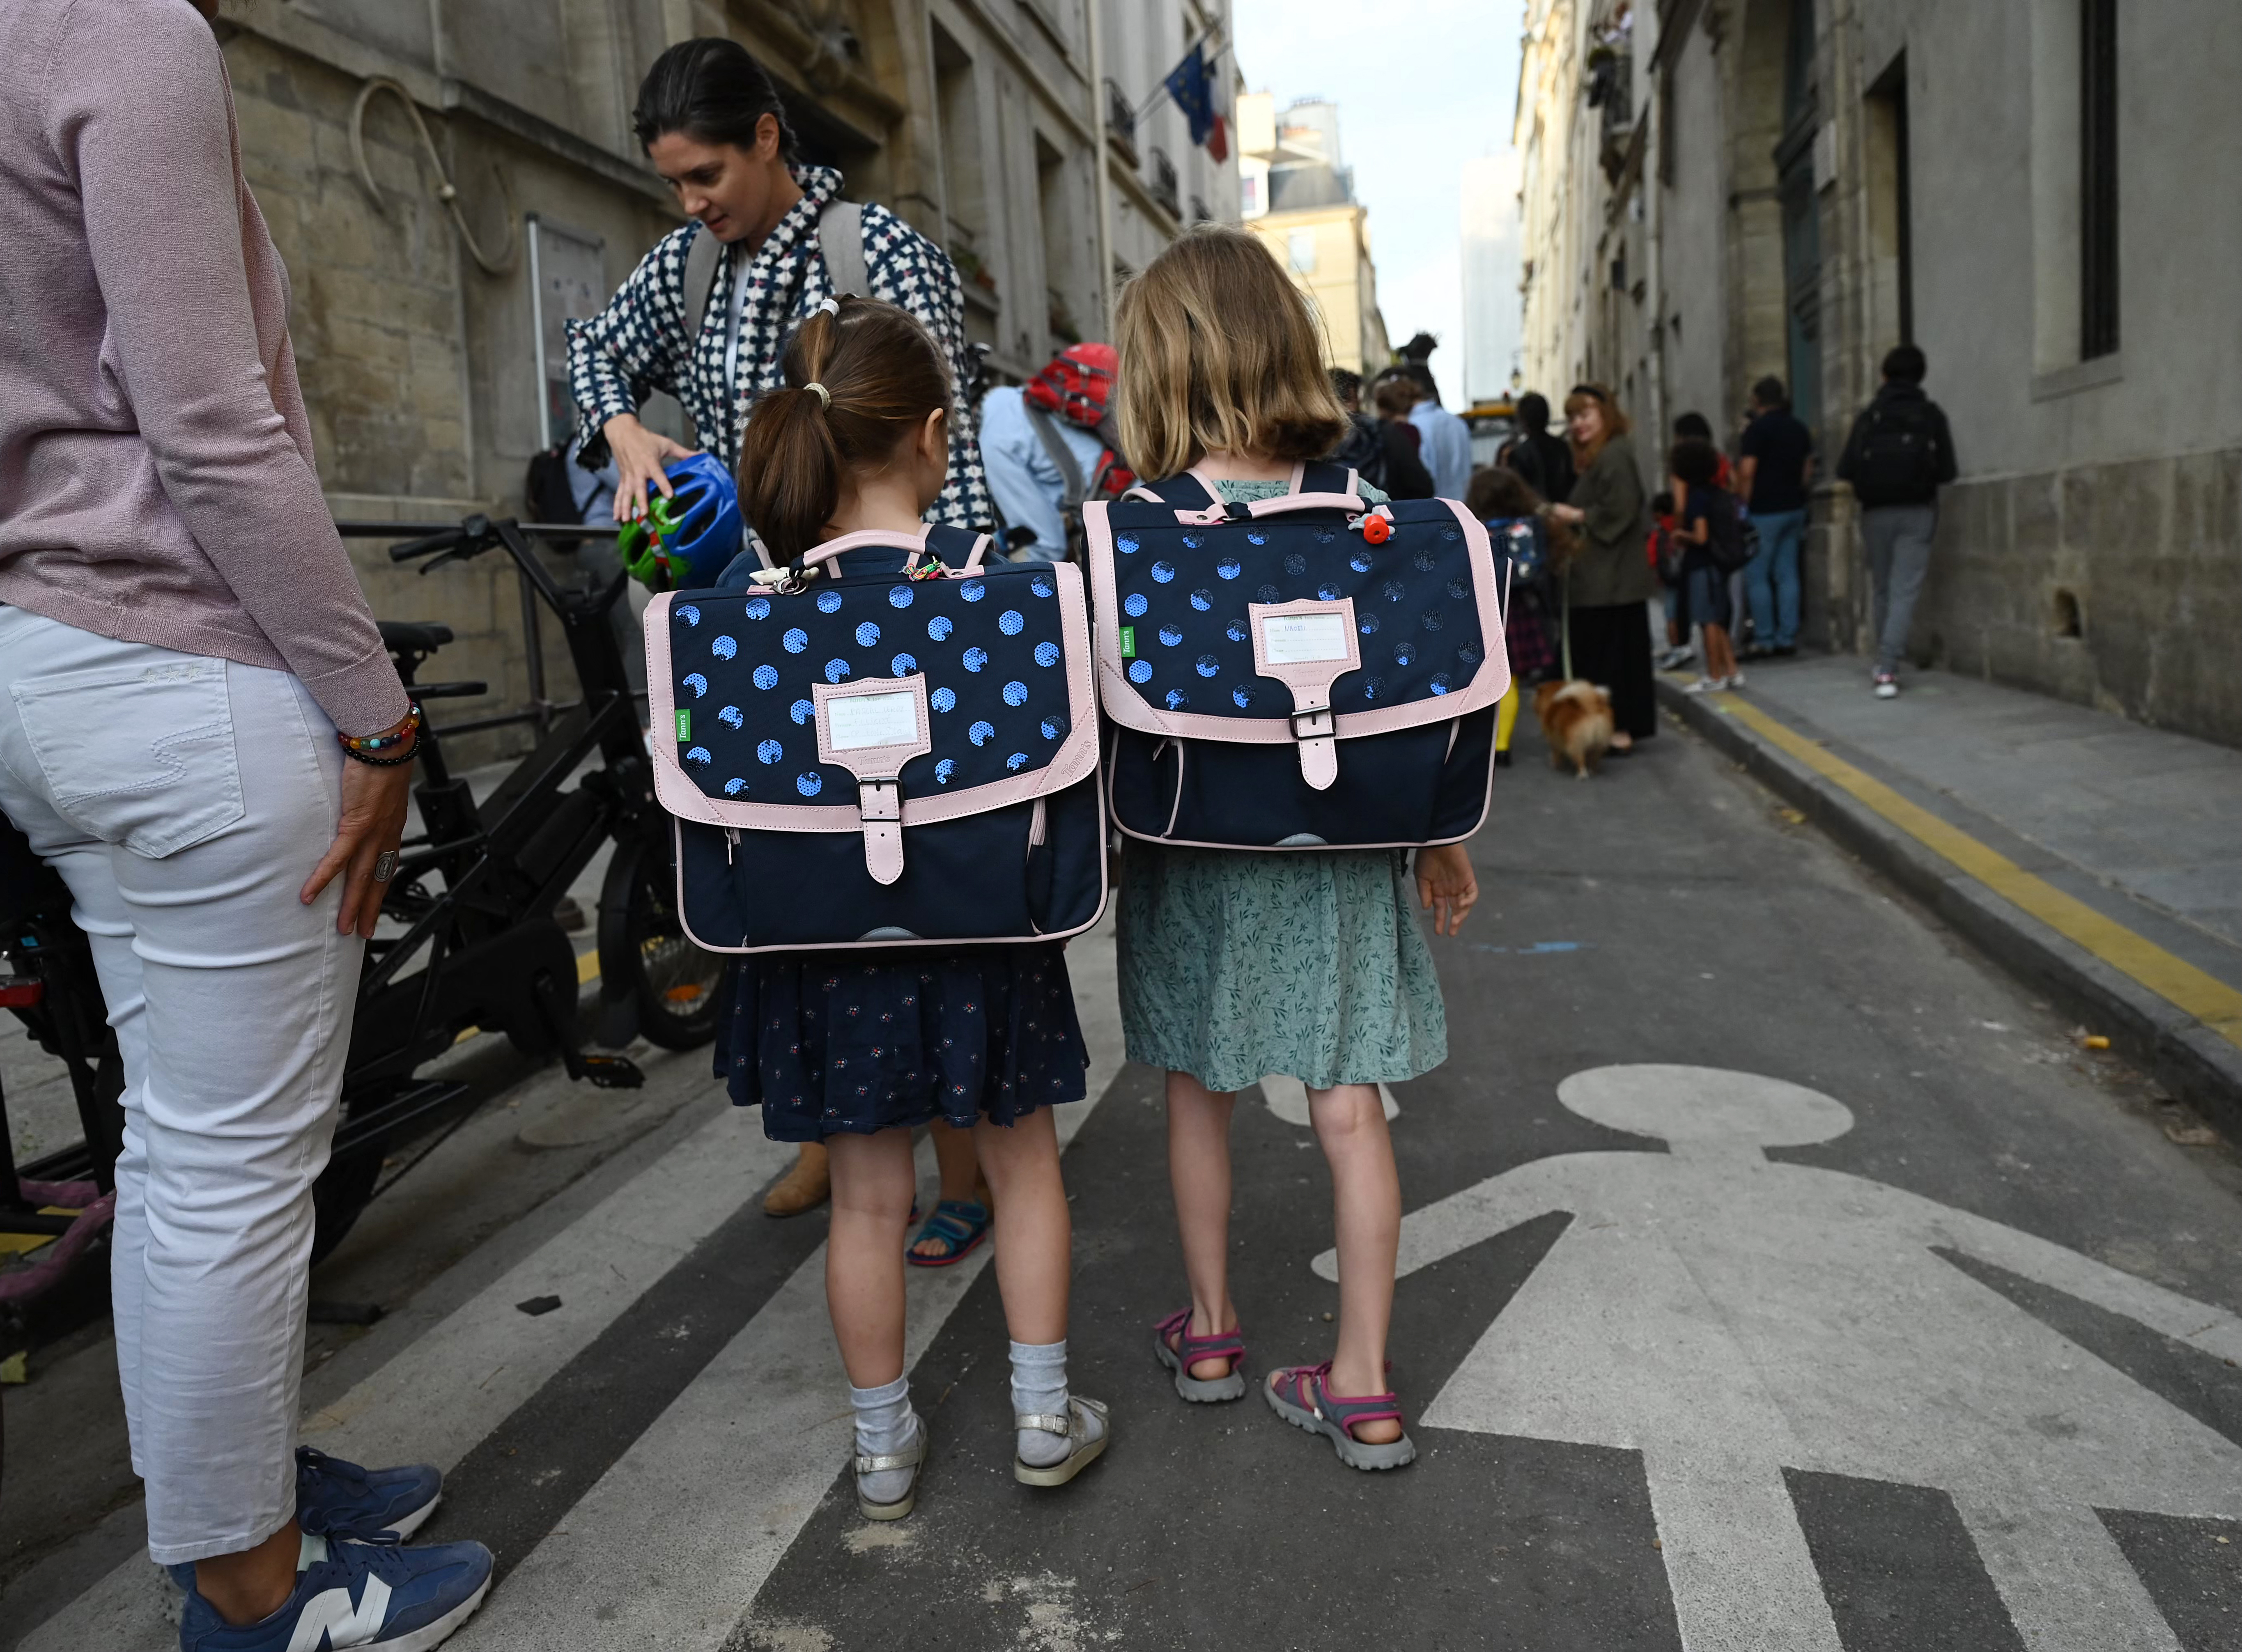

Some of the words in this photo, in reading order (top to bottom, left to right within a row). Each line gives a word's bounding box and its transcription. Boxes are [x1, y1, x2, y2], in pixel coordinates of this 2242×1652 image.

[1122, 630, 1130, 654] Tann's
[858, 755, 891, 766] Tann's
[1061, 740, 1092, 778] Tann's
